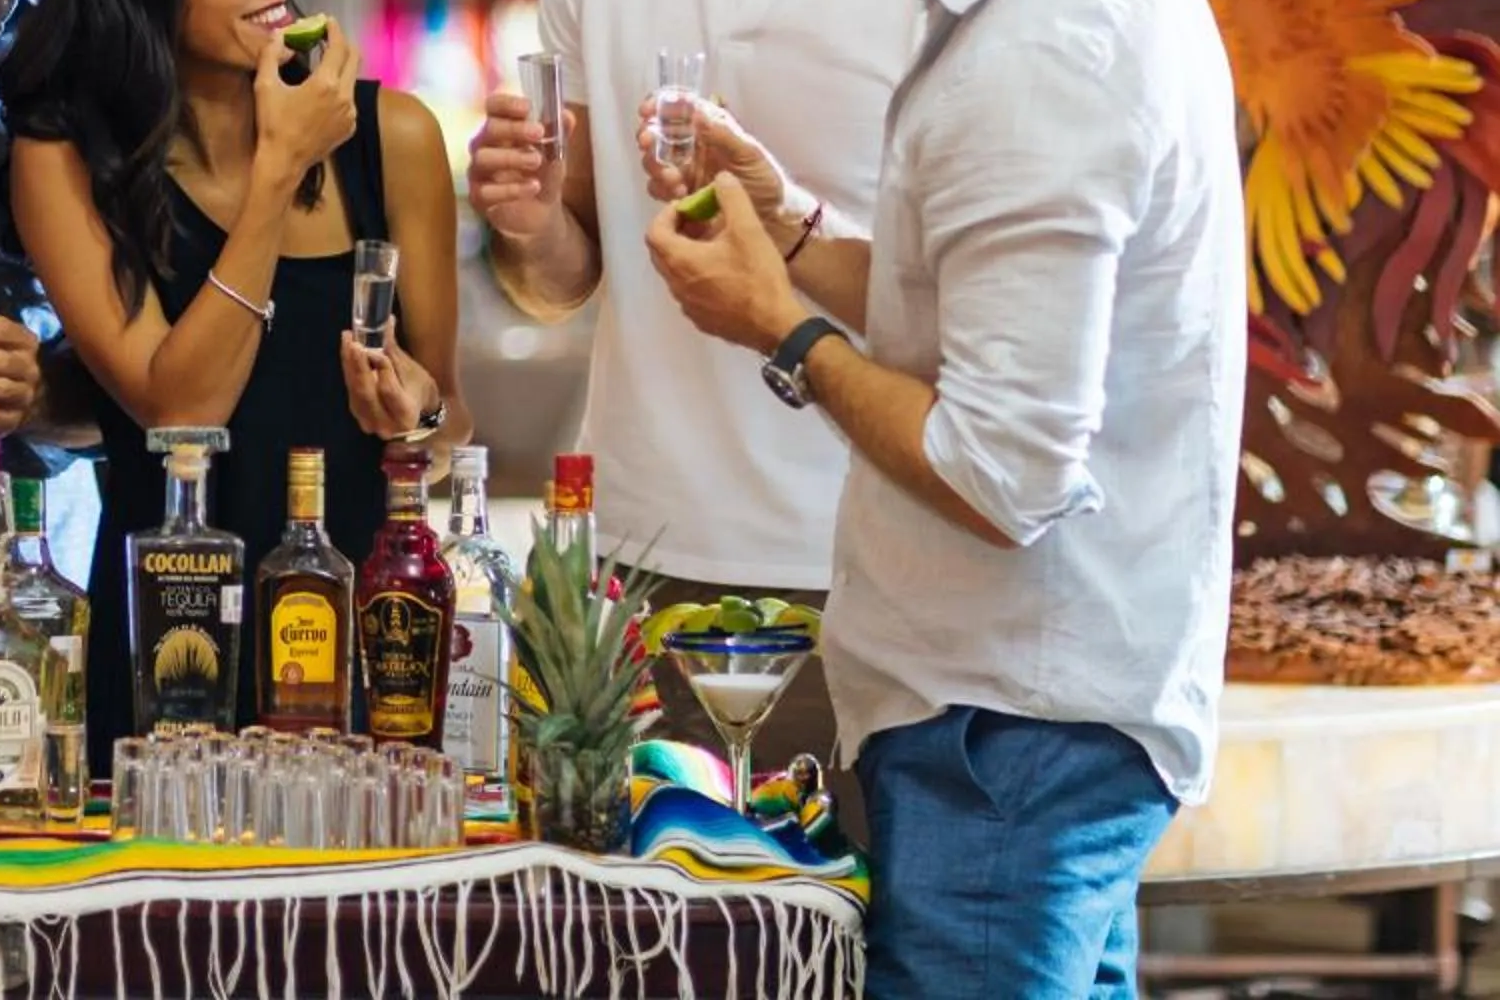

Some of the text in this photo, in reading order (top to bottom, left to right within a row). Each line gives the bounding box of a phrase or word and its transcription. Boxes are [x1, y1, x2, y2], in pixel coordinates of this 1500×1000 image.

[145, 553, 232, 574] COCOLLAN
[161, 591, 217, 609] TEQUILA
[280, 624, 327, 645] Cuervo
[449, 680, 492, 698] ndain
